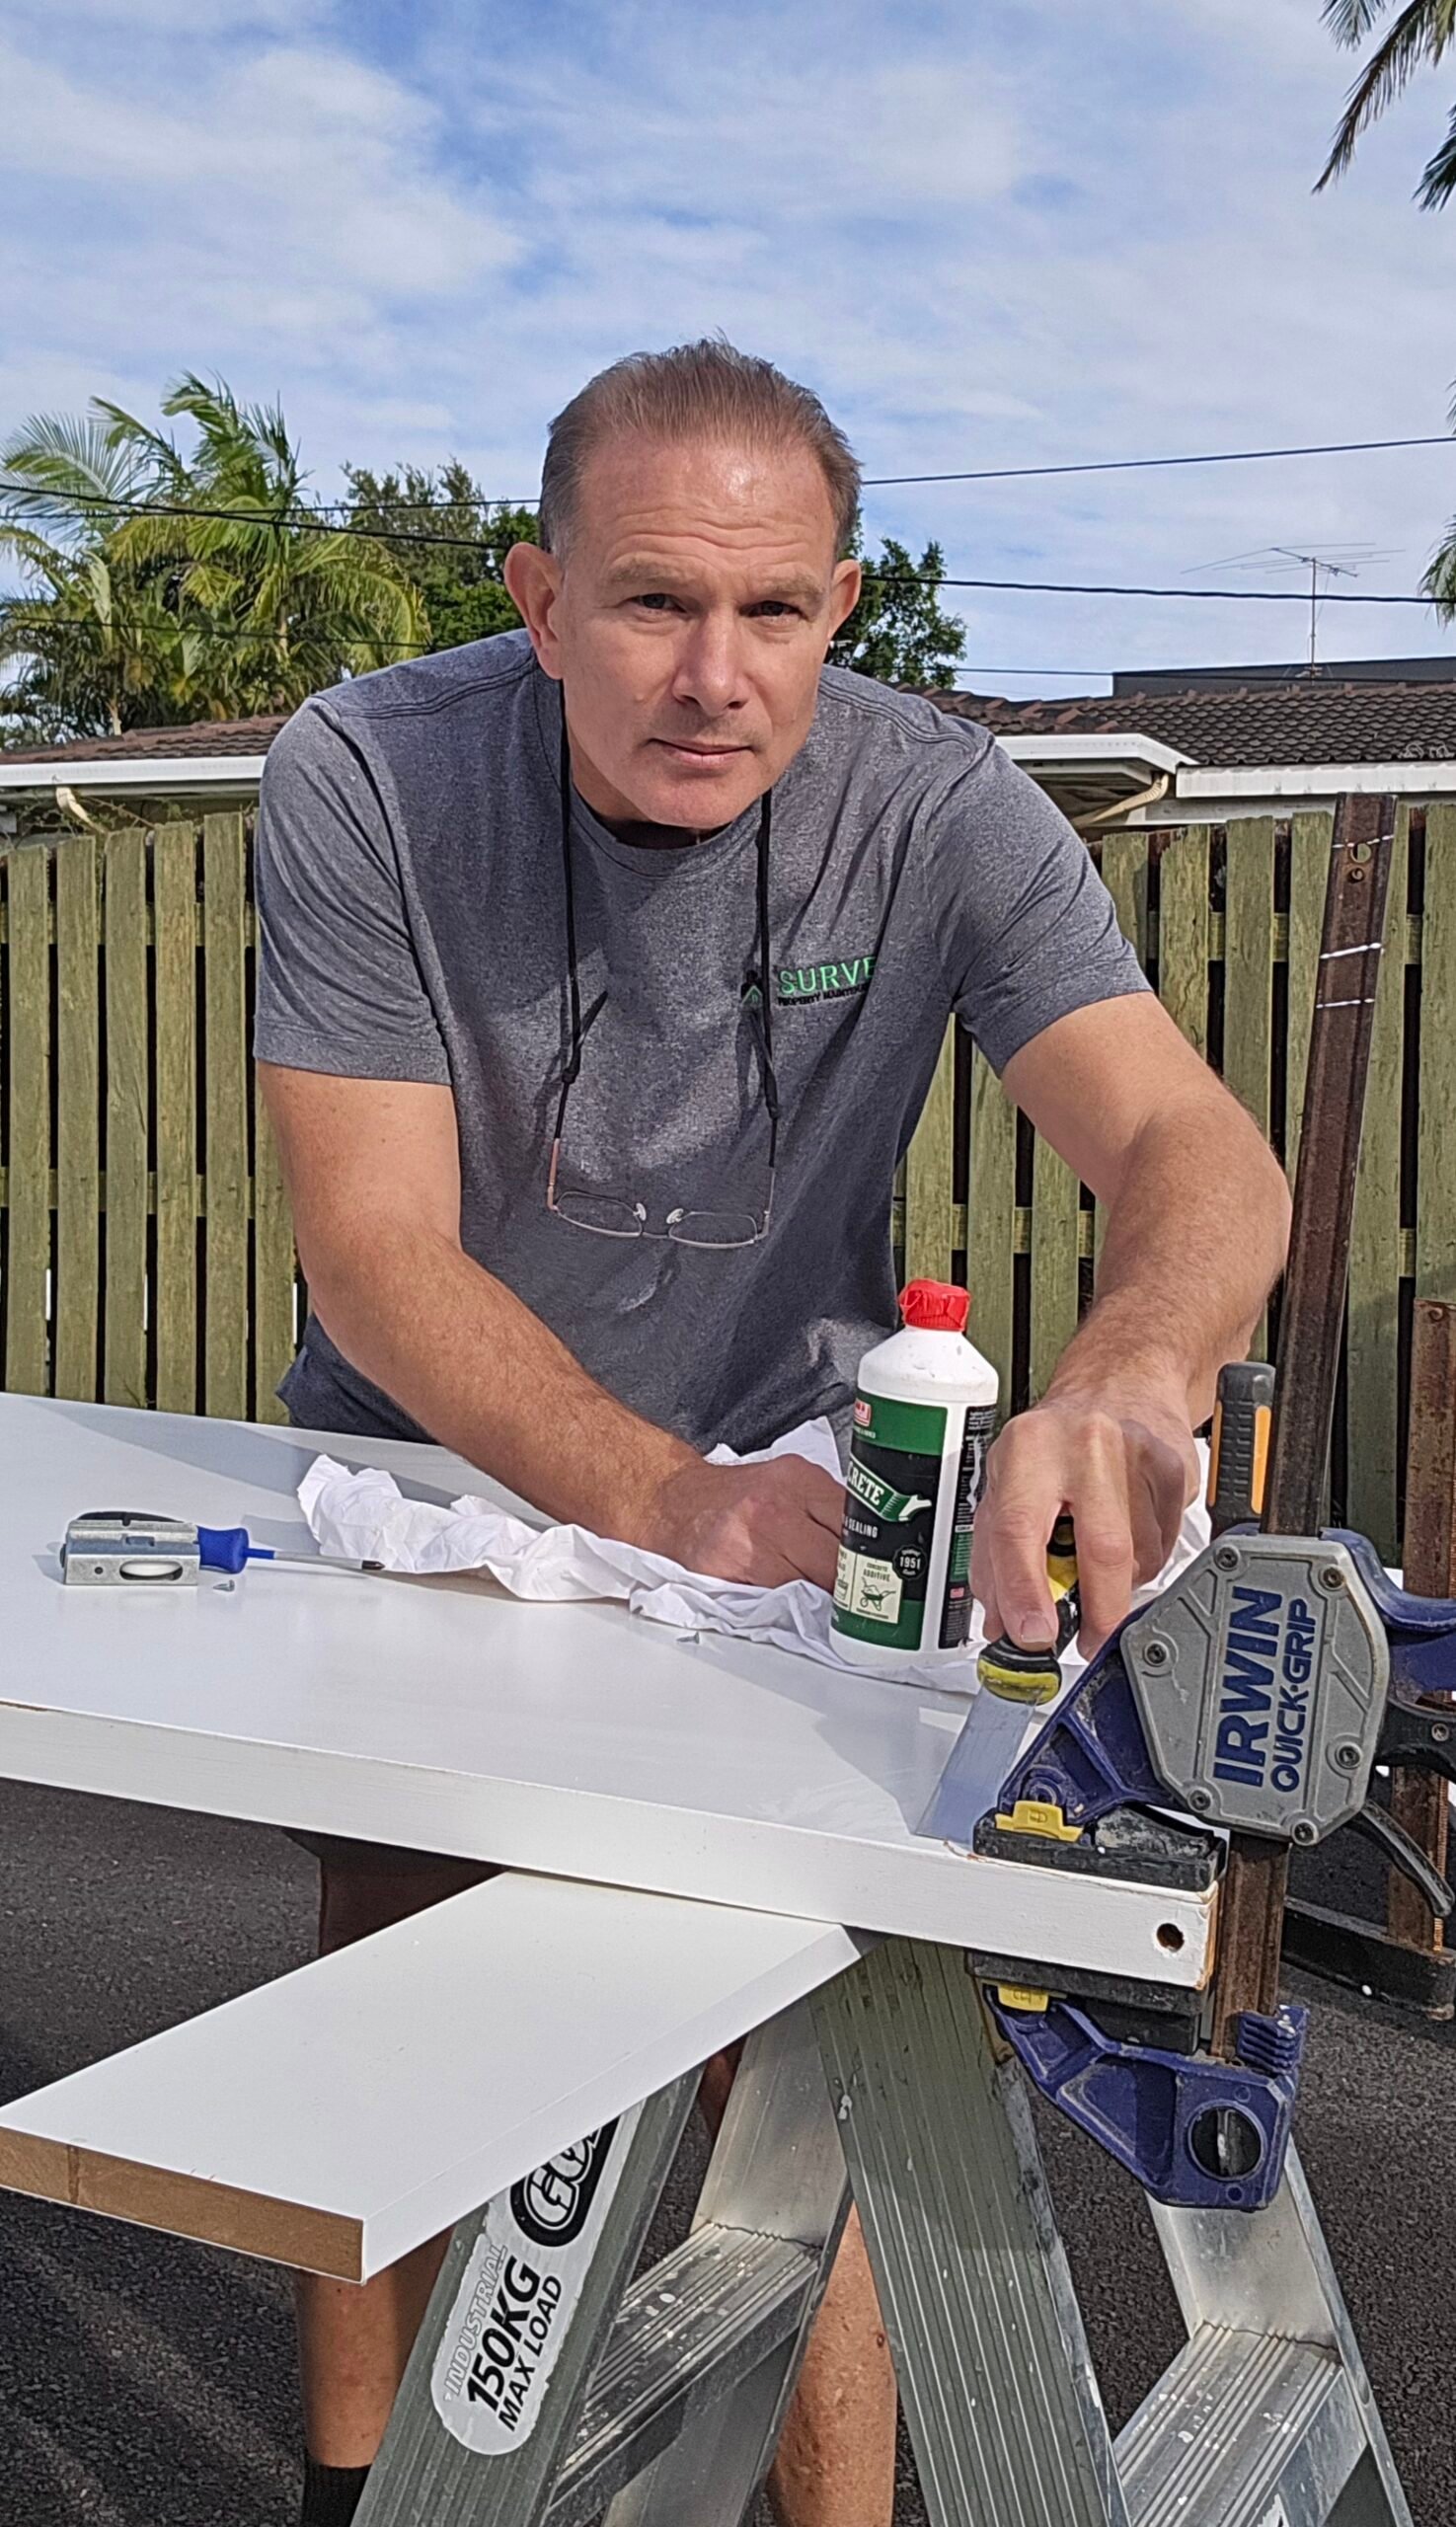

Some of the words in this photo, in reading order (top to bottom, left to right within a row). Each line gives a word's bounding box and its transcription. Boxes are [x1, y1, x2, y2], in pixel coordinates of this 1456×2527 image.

[899, 1556, 922, 1570] 1951
[1212, 1585, 1282, 1788] IRWIN
[444, 2243, 507, 2397] INDUSTRIAL
[466, 2255, 541, 2413] 150KG
[497, 2355, 535, 2432] MAX
[523, 2274, 562, 2357] LOAD
